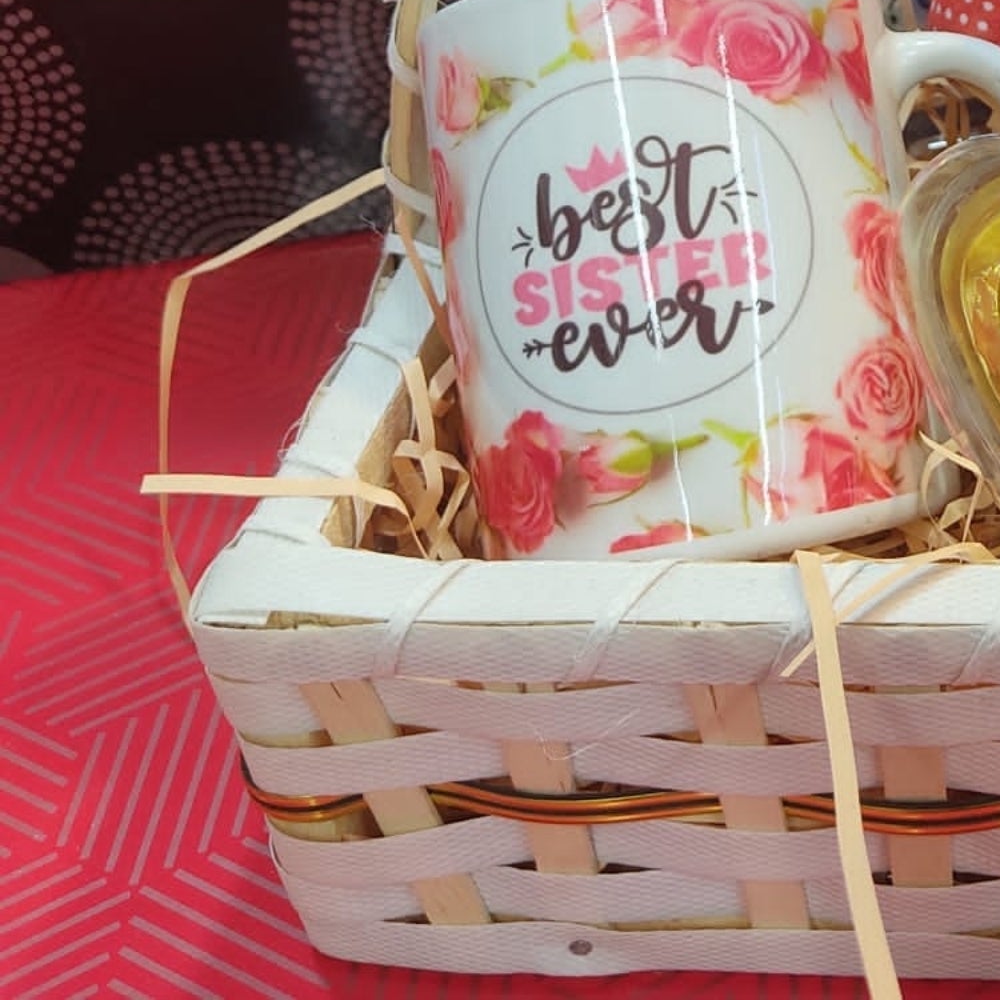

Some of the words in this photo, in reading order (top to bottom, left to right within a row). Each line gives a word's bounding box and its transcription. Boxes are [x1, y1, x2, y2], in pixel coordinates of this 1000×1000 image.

[535, 135, 732, 262] best
[512, 230, 774, 328] SISTER
[550, 279, 744, 373] ever
